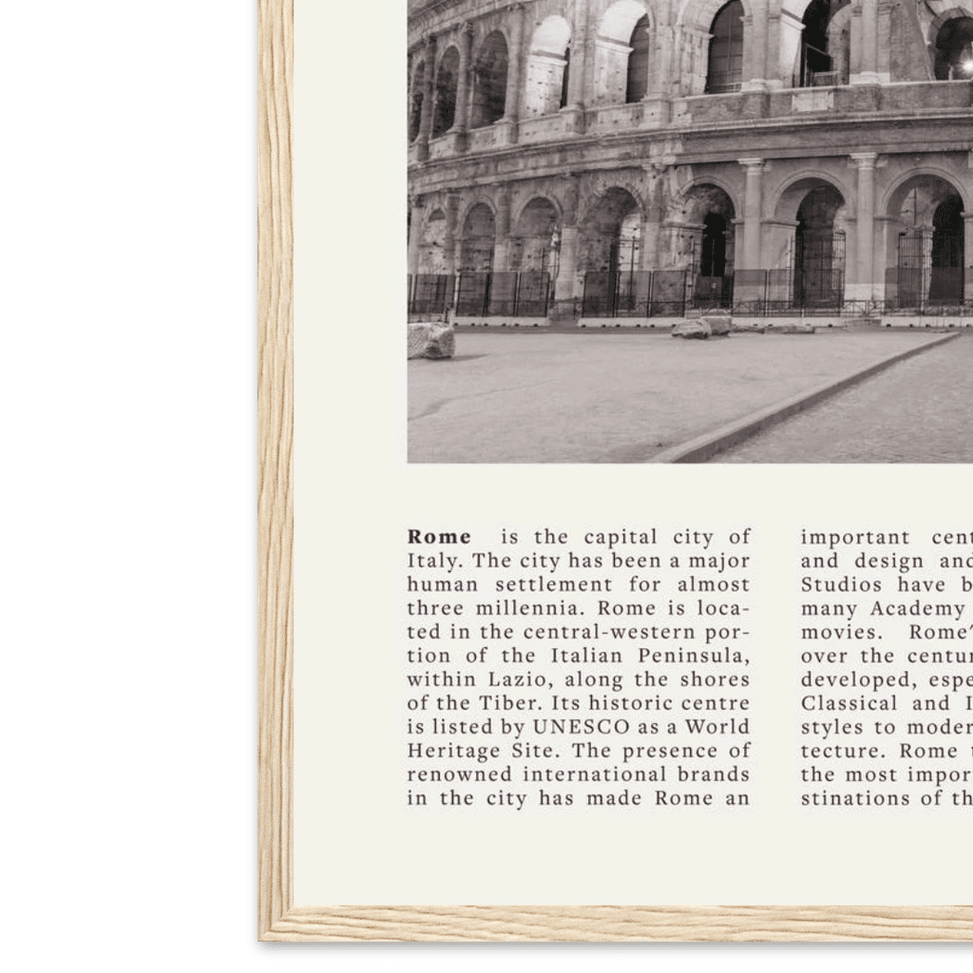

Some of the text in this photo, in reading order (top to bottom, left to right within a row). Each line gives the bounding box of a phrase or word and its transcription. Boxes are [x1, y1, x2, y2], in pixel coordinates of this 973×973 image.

[408, 528, 751, 549] Rome is the capital city of
[802, 529, 909, 549] important
[802, 552, 838, 568] and
[855, 552, 923, 573] design
[408, 576, 749, 592] human settlement for almost
[802, 576, 881, 592] Studios
[898, 576, 945, 592] have
[407, 599, 749, 615] three millennia. Rome is loca-
[407, 623, 749, 644] ted in the central-western por-
[408, 647, 749, 666] tion of the Italian Peninsula,
[801, 652, 847, 663] over
[861, 647, 894, 663] the
[407, 671, 749, 692] within Lazio, along the shores
[801, 671, 916, 692] developed,
[408, 694, 749, 710] of the Tiber. Its historic centre
[802, 695, 896, 711] Classical
[913, 694, 949, 710] and
[408, 718, 749, 739] is listed by UNESCO as a World
[802, 718, 862, 739] styles
[875, 722, 895, 734] to
[408, 742, 751, 763] Heritage Site. The presence of
[408, 765, 749, 781] renowned international brands
[801, 766, 834, 782] the
[846, 769, 896, 782] most
[802, 790, 909, 806] stinations
[921, 789, 943, 805] of
